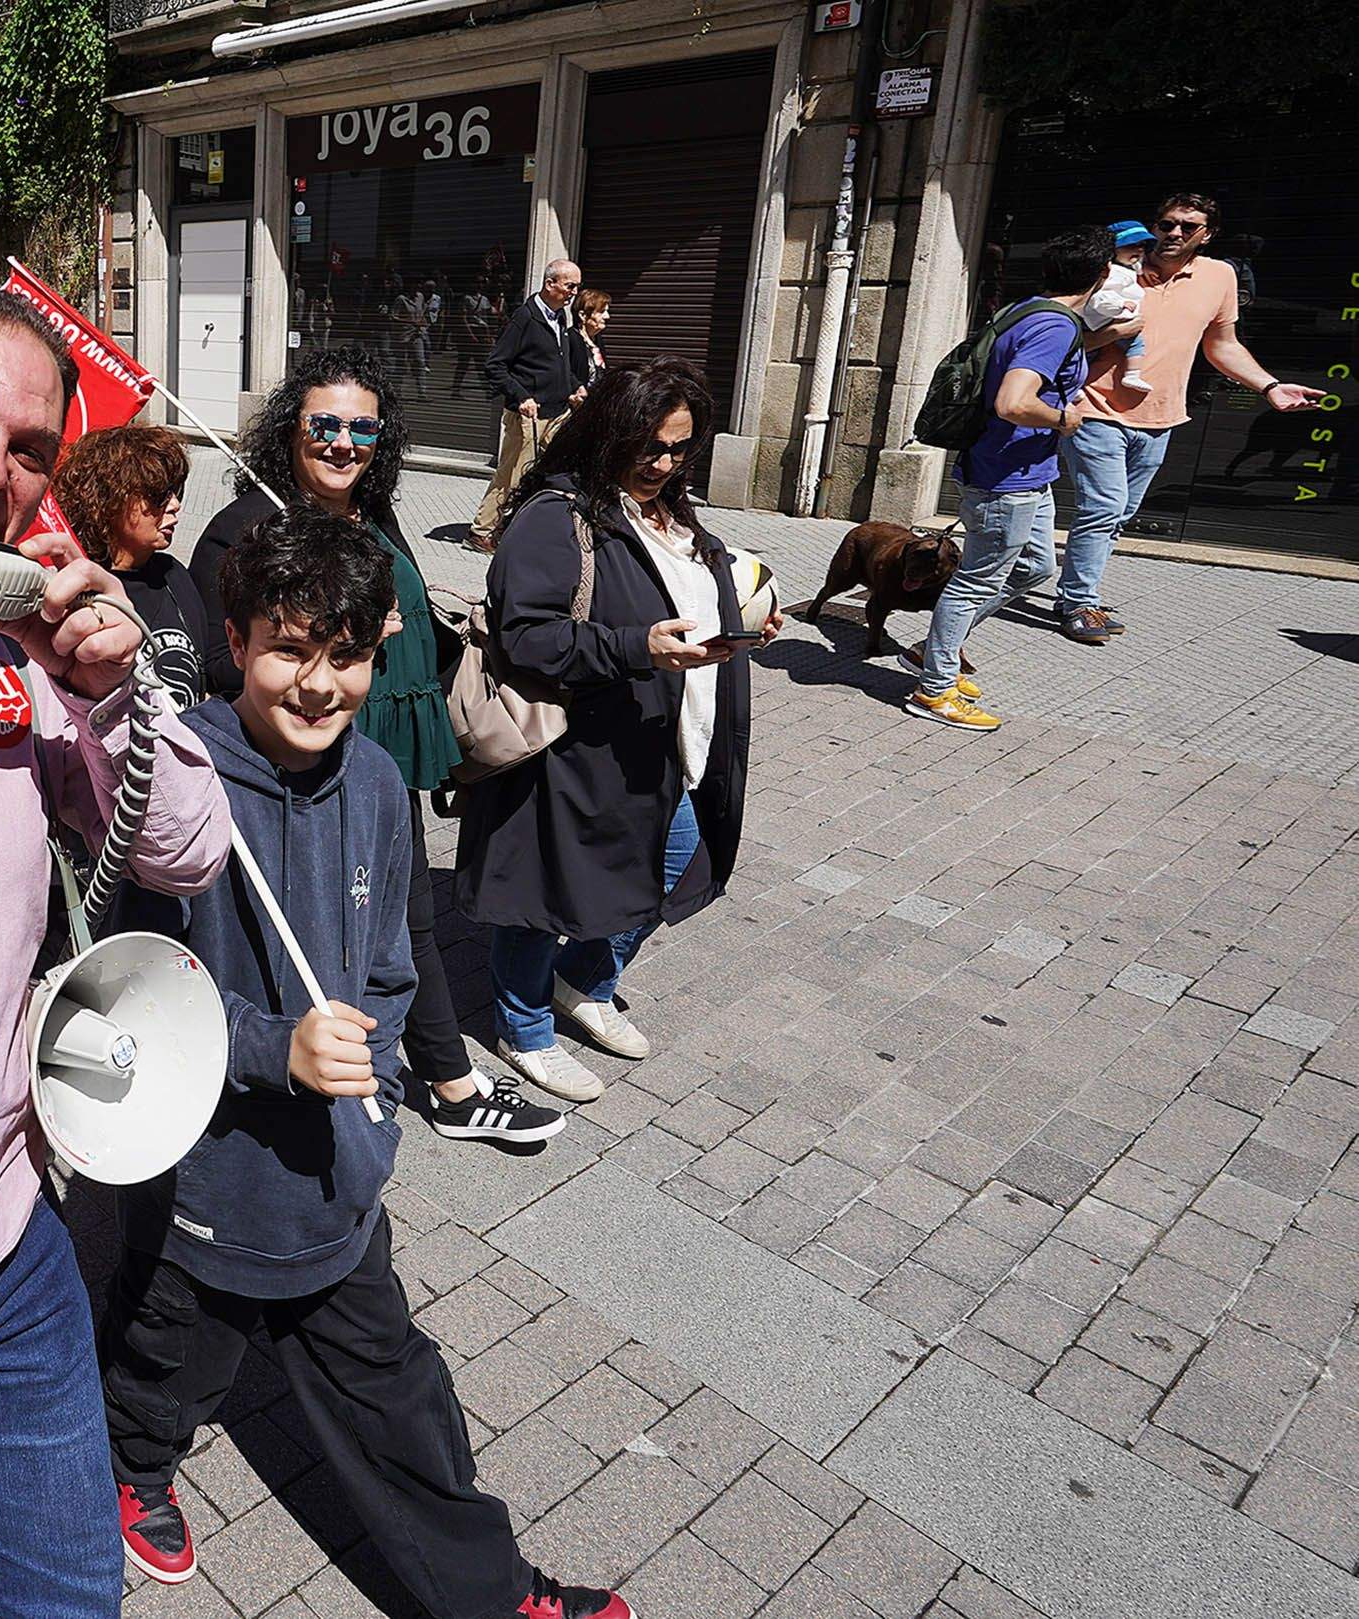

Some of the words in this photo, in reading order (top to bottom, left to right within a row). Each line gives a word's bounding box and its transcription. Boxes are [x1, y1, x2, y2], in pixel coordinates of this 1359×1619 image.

[879, 87, 929, 98] CONECTADA
[888, 81, 921, 90] ALARMA
[422, 105, 491, 161] 36
[1295, 364, 1350, 501] COSTA
